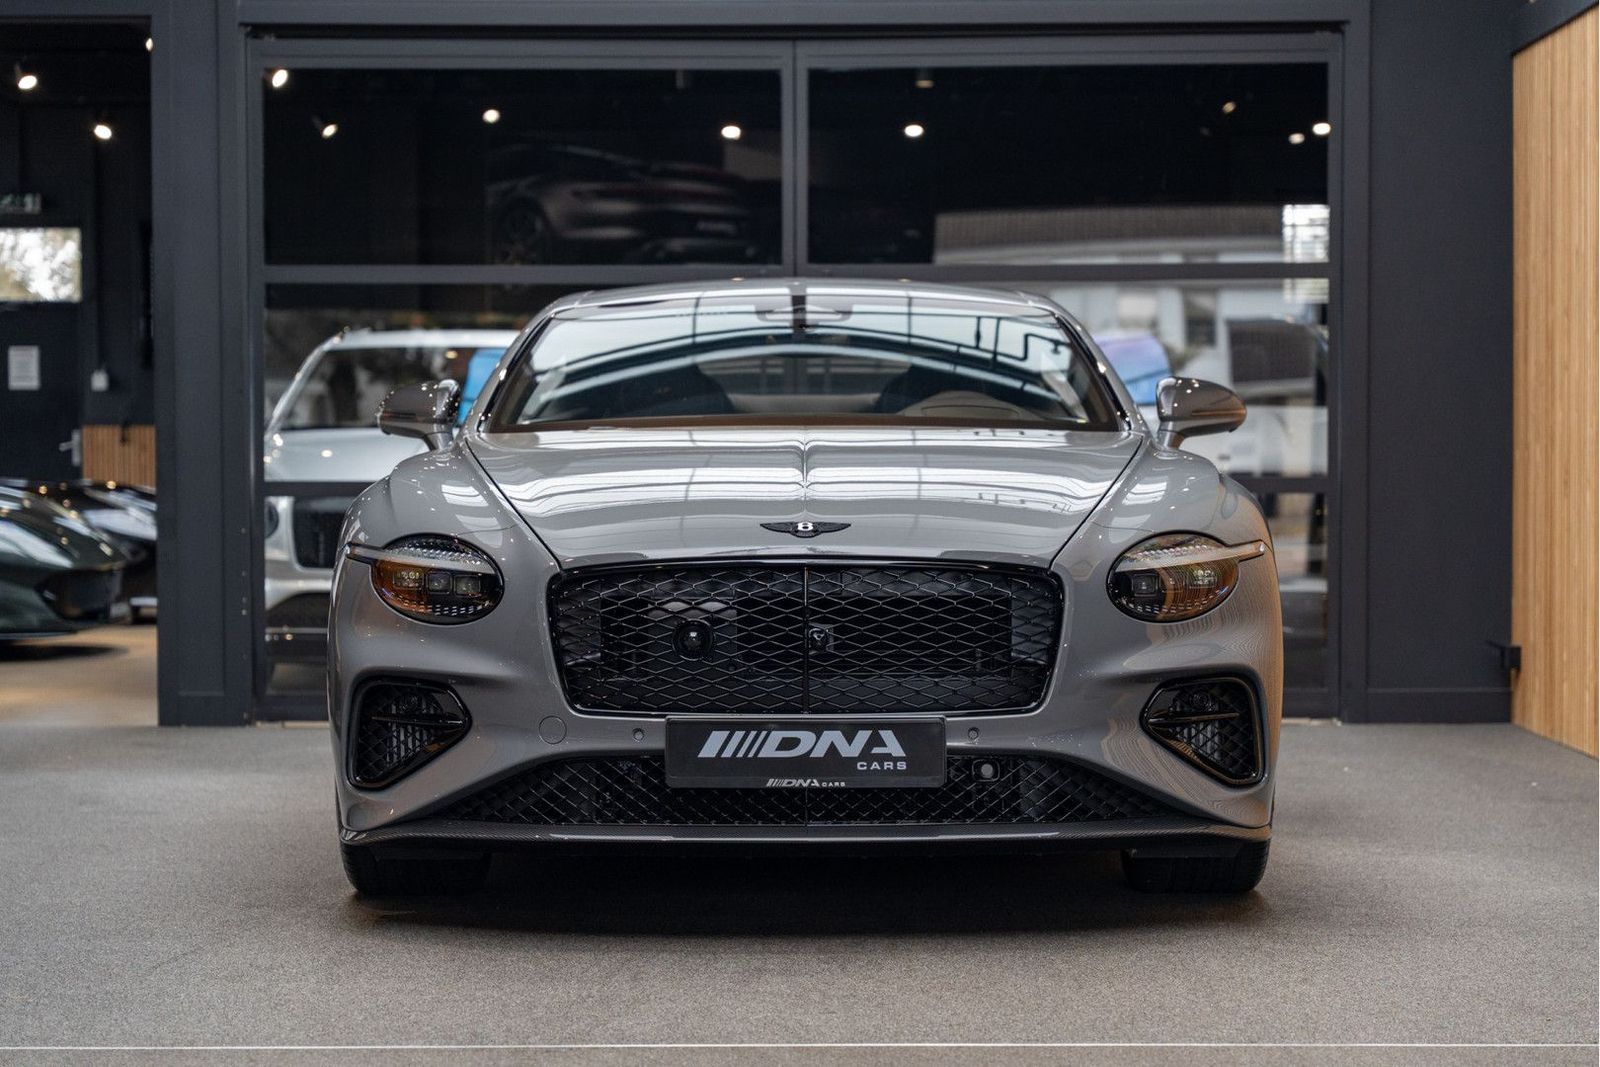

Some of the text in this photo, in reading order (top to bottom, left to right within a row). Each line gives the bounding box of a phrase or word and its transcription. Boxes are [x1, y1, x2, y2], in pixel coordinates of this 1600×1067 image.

[797, 521, 814, 532] B
[756, 730, 906, 758] DNA
[857, 761, 907, 770] CARS
[781, 778, 820, 787] DNA
